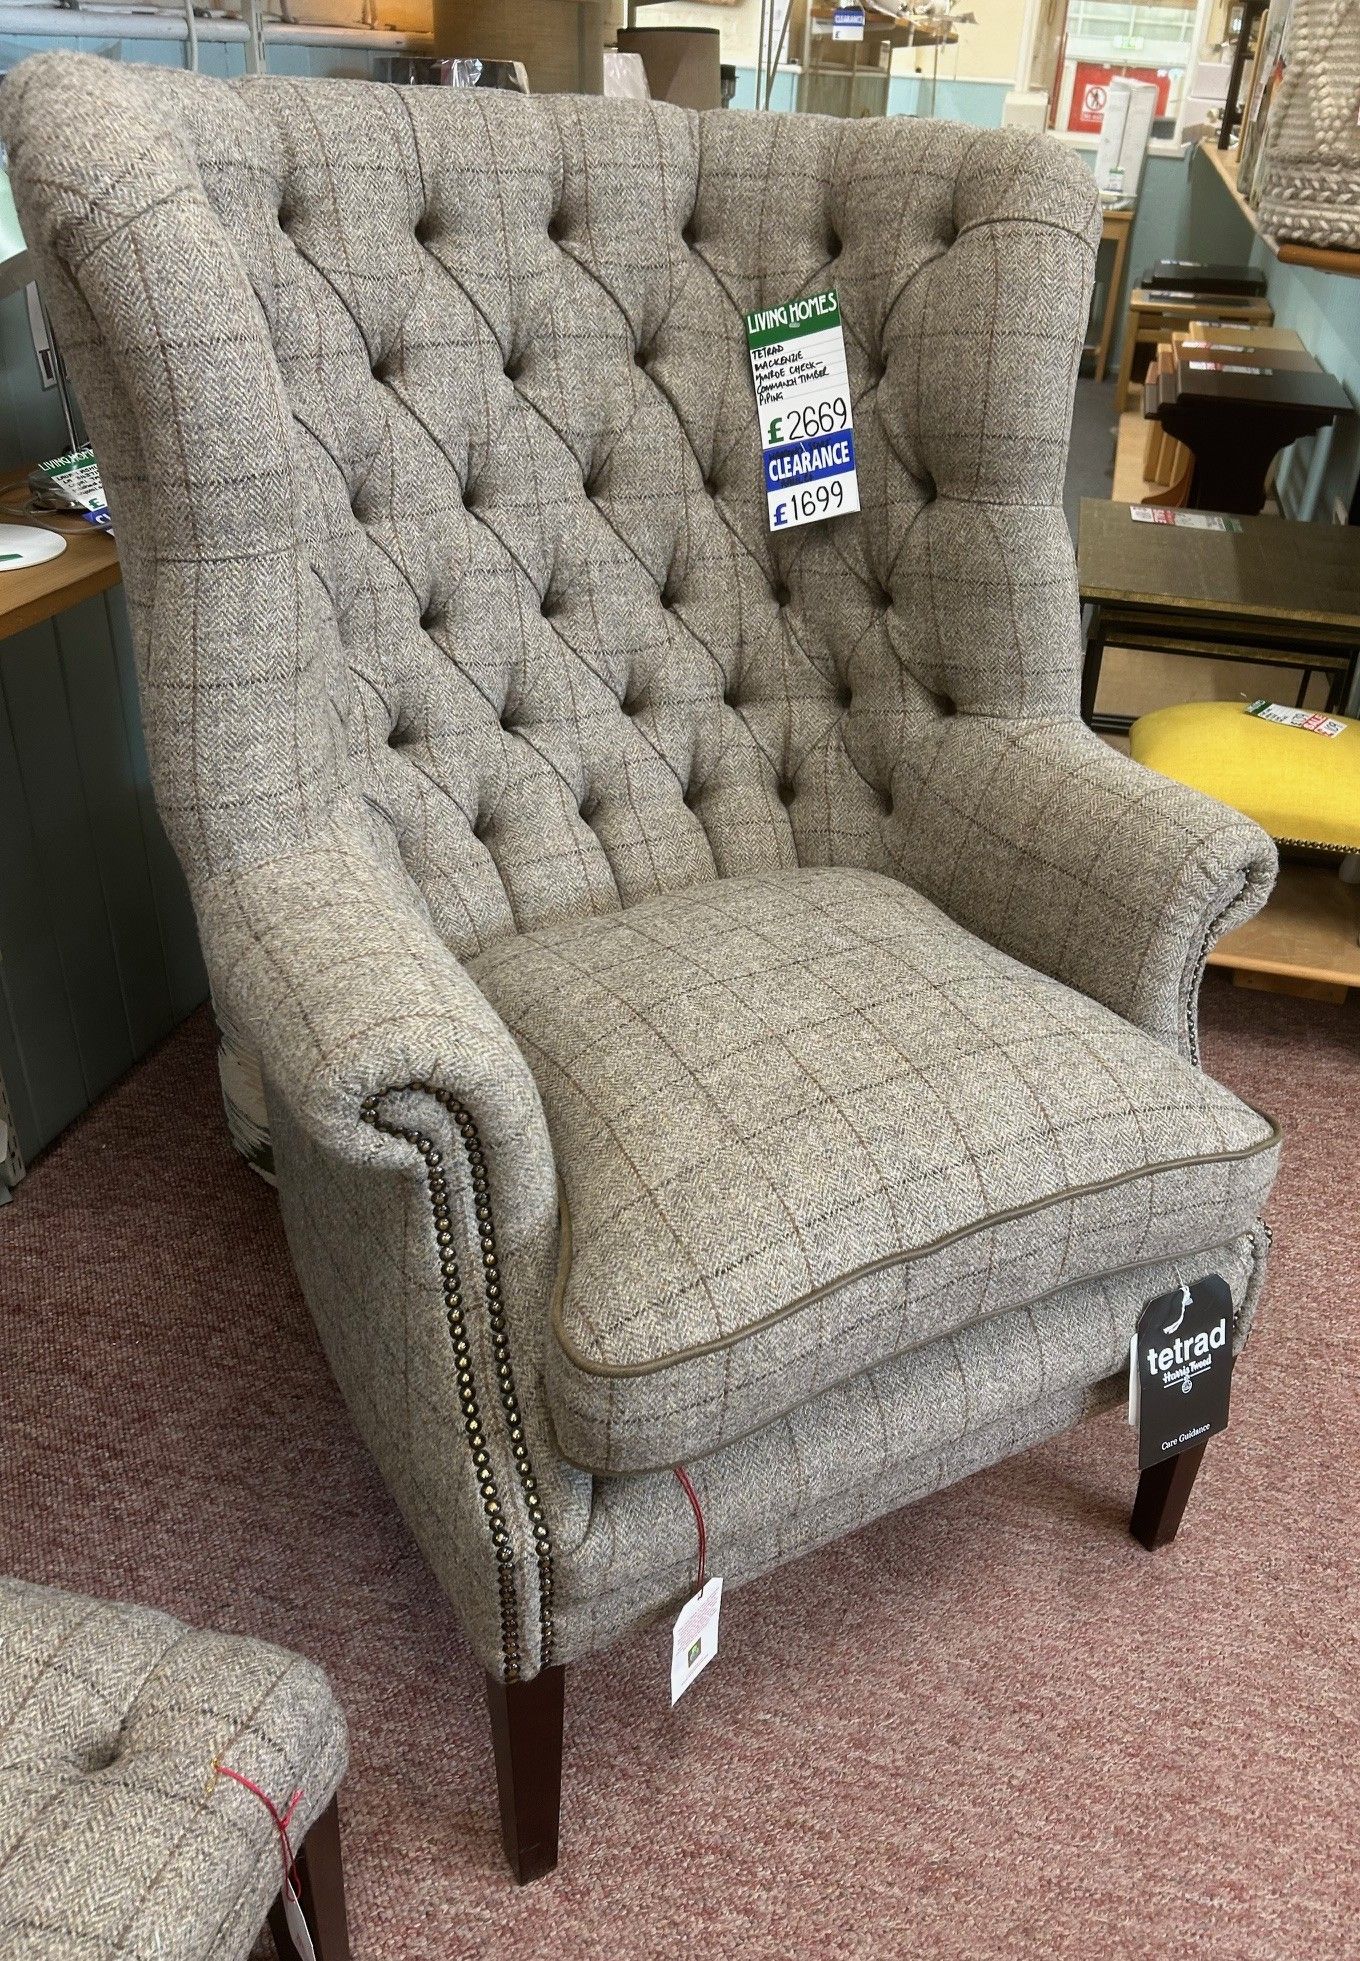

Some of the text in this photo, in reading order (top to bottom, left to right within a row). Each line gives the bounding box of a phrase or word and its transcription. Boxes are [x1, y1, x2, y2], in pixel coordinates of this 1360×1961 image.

[747, 292, 837, 334] LIVING HOMES
[752, 345, 784, 360] TETRAD
[754, 350, 804, 372] MACKENZIE
[798, 366, 829, 383] TIMBER
[759, 392, 784, 406] PIPING
[38, 449, 95, 471] LIVING HOM
[768, 441, 850, 482] CLEARANCE
[1147, 1318, 1226, 1376] tetrad
[1162, 1353, 1211, 1384] Harris Tweed
[1161, 1423, 1211, 1450] Care Guidance
